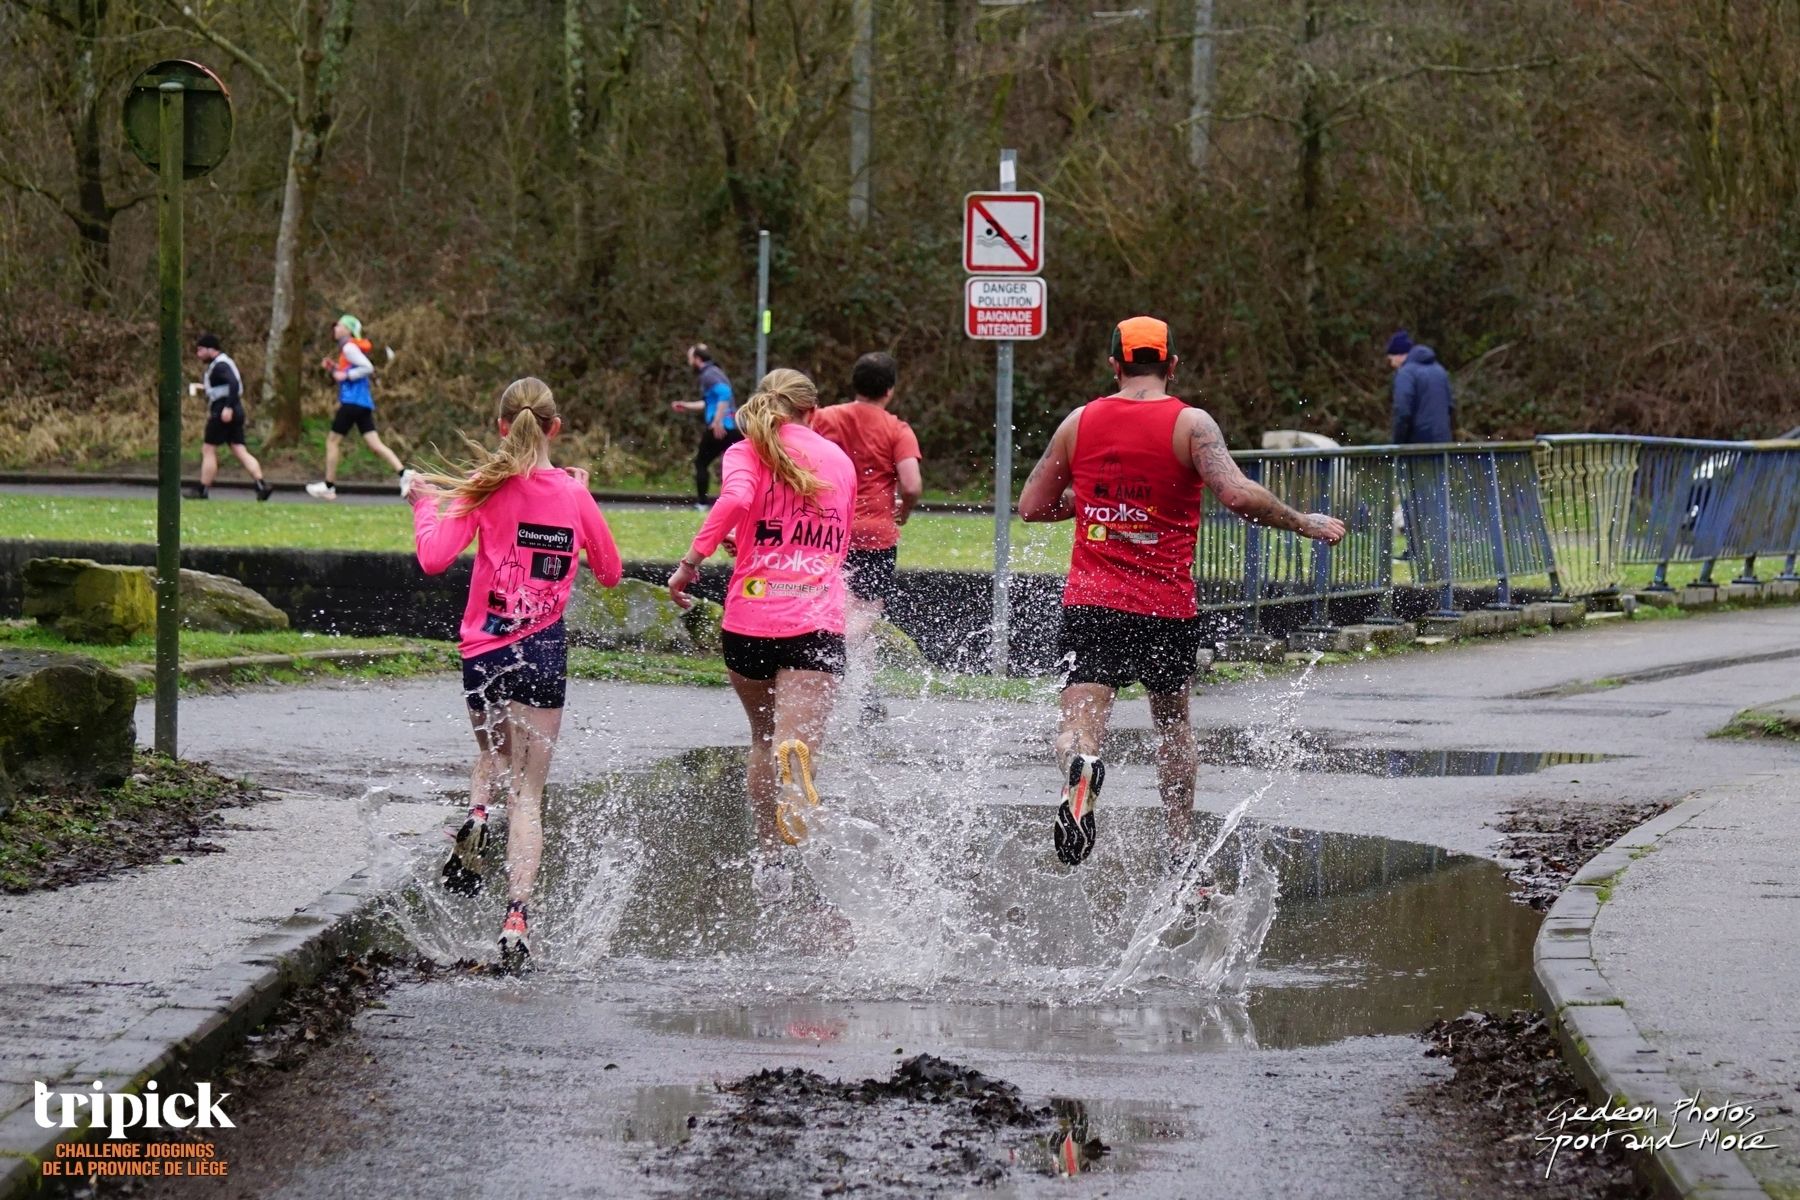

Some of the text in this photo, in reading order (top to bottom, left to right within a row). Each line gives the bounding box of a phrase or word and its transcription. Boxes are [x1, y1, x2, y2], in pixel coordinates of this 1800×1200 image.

[983, 283, 1027, 293] DANGER
[978, 296, 1032, 306] POLLUTION
[976, 310, 1032, 323] BAIGNADE
[976, 323, 1032, 336] INTERDITE
[1116, 484, 1152, 498] AMAY
[1083, 502, 1149, 523] trakks
[518, 528, 568, 545] Chlorophyl
[790, 520, 845, 553] AMAY
